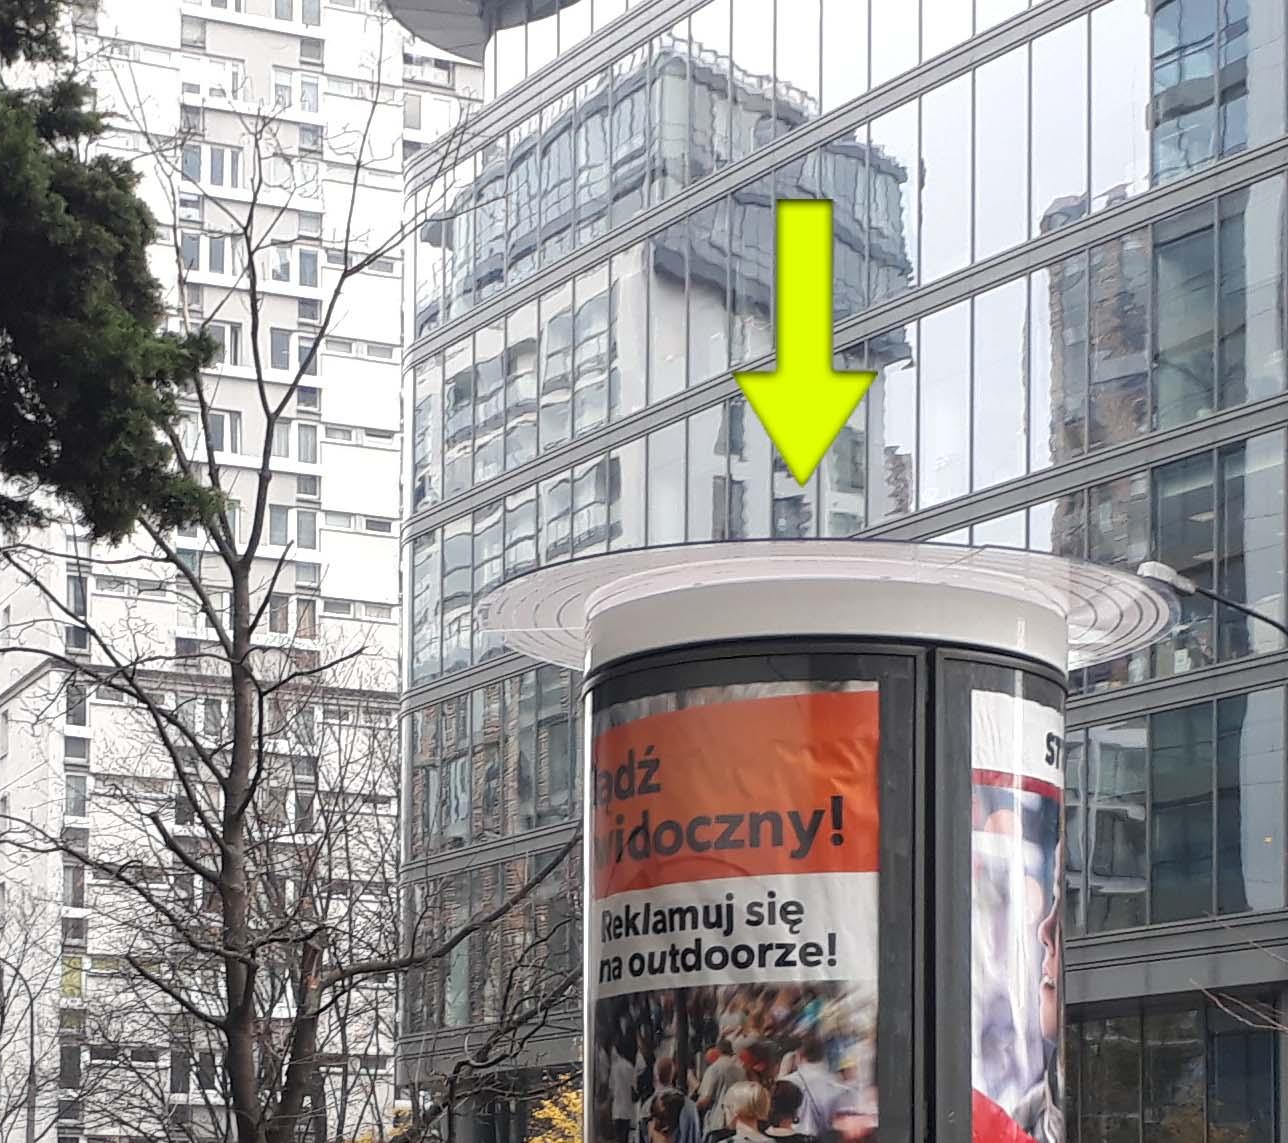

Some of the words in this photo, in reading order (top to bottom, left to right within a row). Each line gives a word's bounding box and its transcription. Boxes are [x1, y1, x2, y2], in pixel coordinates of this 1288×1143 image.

[593, 744, 661, 814] ądź
[595, 795, 845, 865] idoczny!
[601, 892, 734, 944] Reklamuj
[745, 891, 805, 935] się
[599, 954, 623, 985] na
[628, 932, 838, 978] outdoorze!
